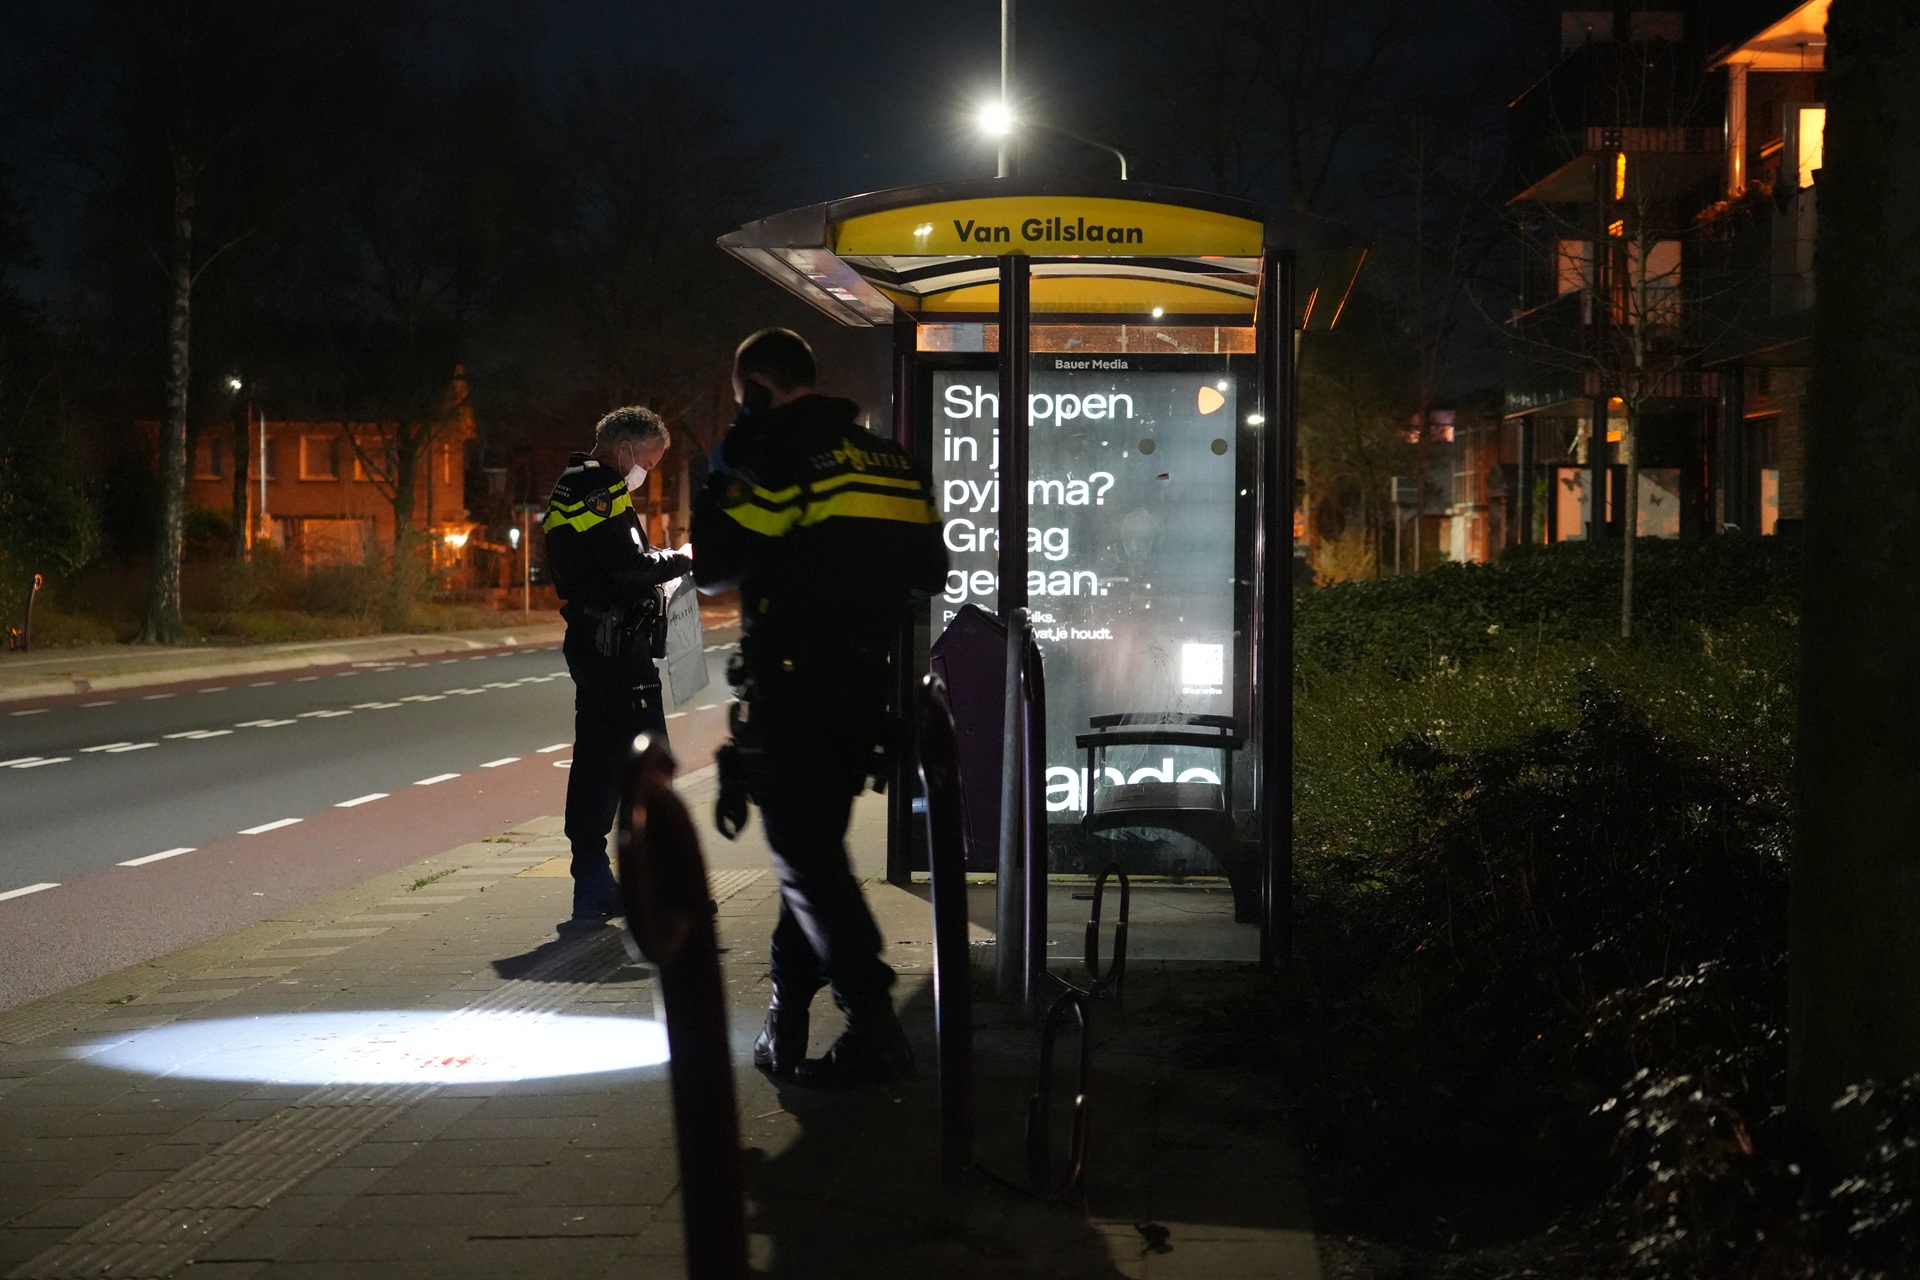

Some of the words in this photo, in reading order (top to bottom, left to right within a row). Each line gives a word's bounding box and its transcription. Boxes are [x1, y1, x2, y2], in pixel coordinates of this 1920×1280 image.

[954, 220, 1010, 243] Van
[1021, 217, 1144, 244] Gilslaan
[1055, 359, 1090, 370] Bauer
[1092, 359, 1128, 370] Media
[943, 384, 1134, 427] Shppen
[944, 429, 978, 462] in
[943, 472, 1114, 512] pyjma?
[943, 518, 1069, 562] Grag
[942, 569, 1109, 604] geaan.
[1071, 627, 1113, 639] houdt.
